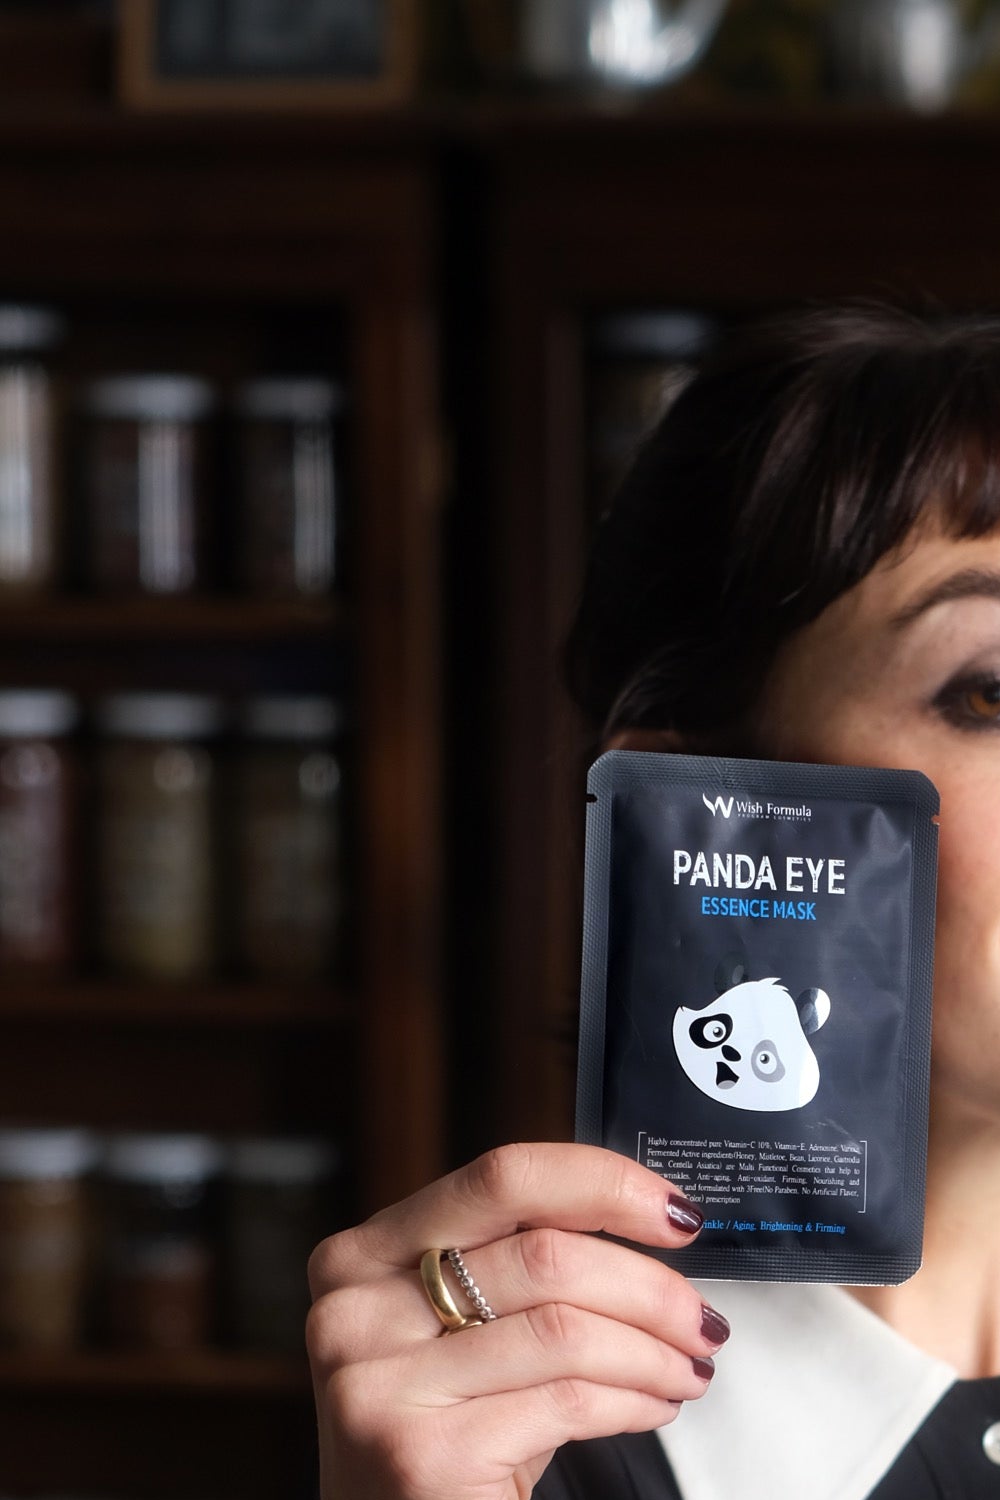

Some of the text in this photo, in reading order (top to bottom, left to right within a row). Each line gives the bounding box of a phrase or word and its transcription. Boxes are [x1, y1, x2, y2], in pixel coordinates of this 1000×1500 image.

[736, 800, 812, 817] Wish Formula
[673, 850, 846, 894] PANDA EYE
[701, 896, 817, 920] ESSENCE MASK
[647, 1137, 668, 1147] Highly
[670, 1139, 707, 1147] concentrated
[724, 1140, 756, 1149] Vitamin-C
[647, 1148, 679, 1157] Fermented
[681, 1149, 700, 1158] Active
[834, 1155, 860, 1164] Gastrodia
[668, 1160, 693, 1169] Centella
[696, 1161, 722, 1170] Asiatica)
[739, 1163, 755, 1171] Multi
[758, 1164, 788, 1172] Functional
[791, 1165, 821, 1174] Cosmetics
[824, 1166, 836, 1174] that
[839, 1167, 851, 1176] help
[813, 1177, 844, 1186] Nourishing
[698, 1184, 730, 1193] formulated
[812, 1187, 838, 1196] Artificial
[705, 1195, 740, 1204] prescription
[760, 1221, 803, 1232] Brightening
[805, 1223, 813, 1232] &
[815, 1223, 846, 1234] Firming
